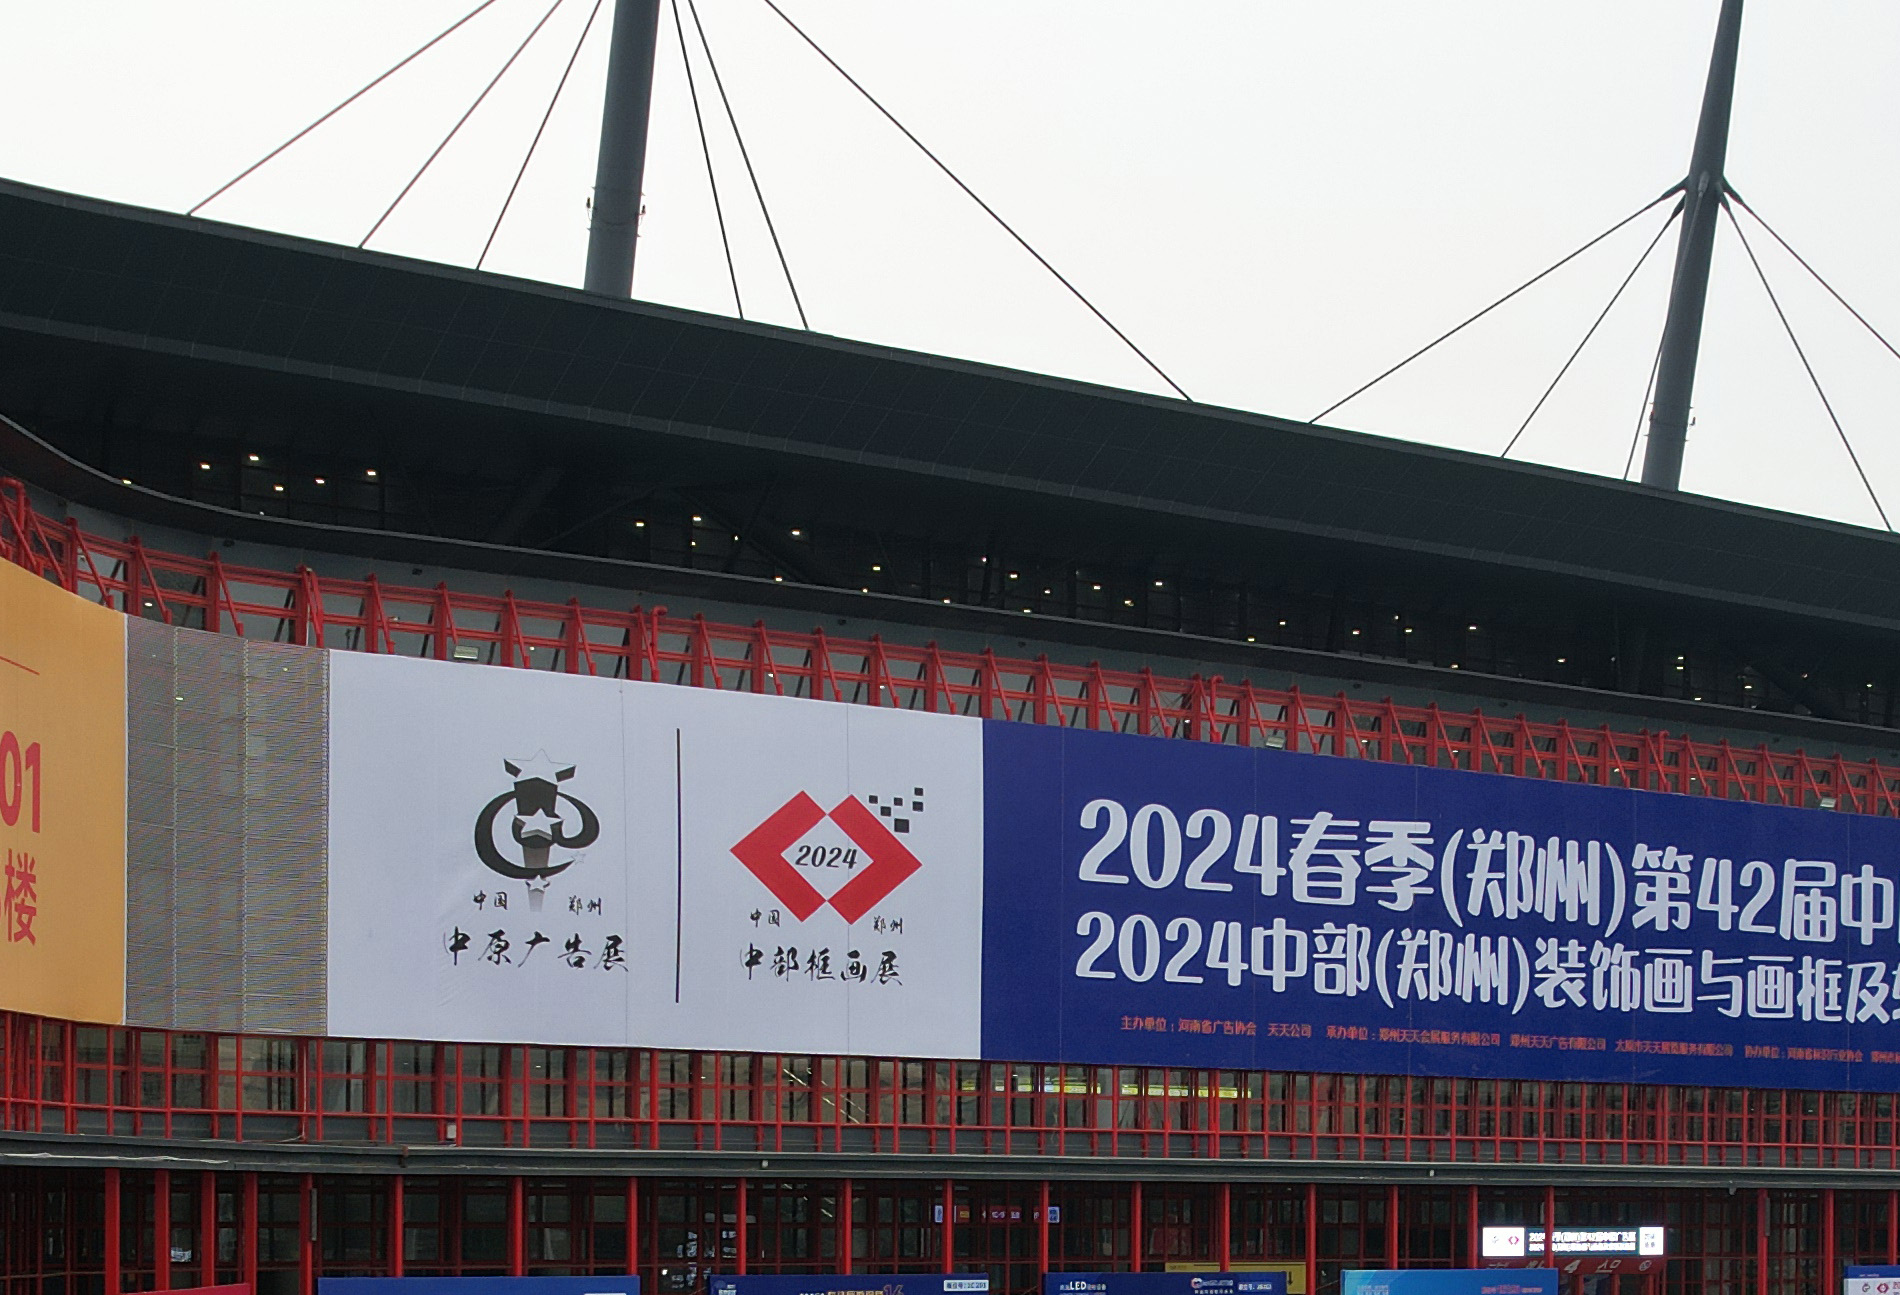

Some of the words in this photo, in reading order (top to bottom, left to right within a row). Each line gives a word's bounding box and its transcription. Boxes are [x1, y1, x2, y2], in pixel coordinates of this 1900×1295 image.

[795, 845, 857, 869] 2024
[4, 849, 37, 946] 楼
[472, 890, 508, 911] 中国
[568, 896, 602, 917] 郑州
[750, 908, 781, 928] 中国
[873, 915, 903, 935] 郑州
[442, 926, 629, 973] 中原广告展
[739, 942, 904, 986] 中部框画展
